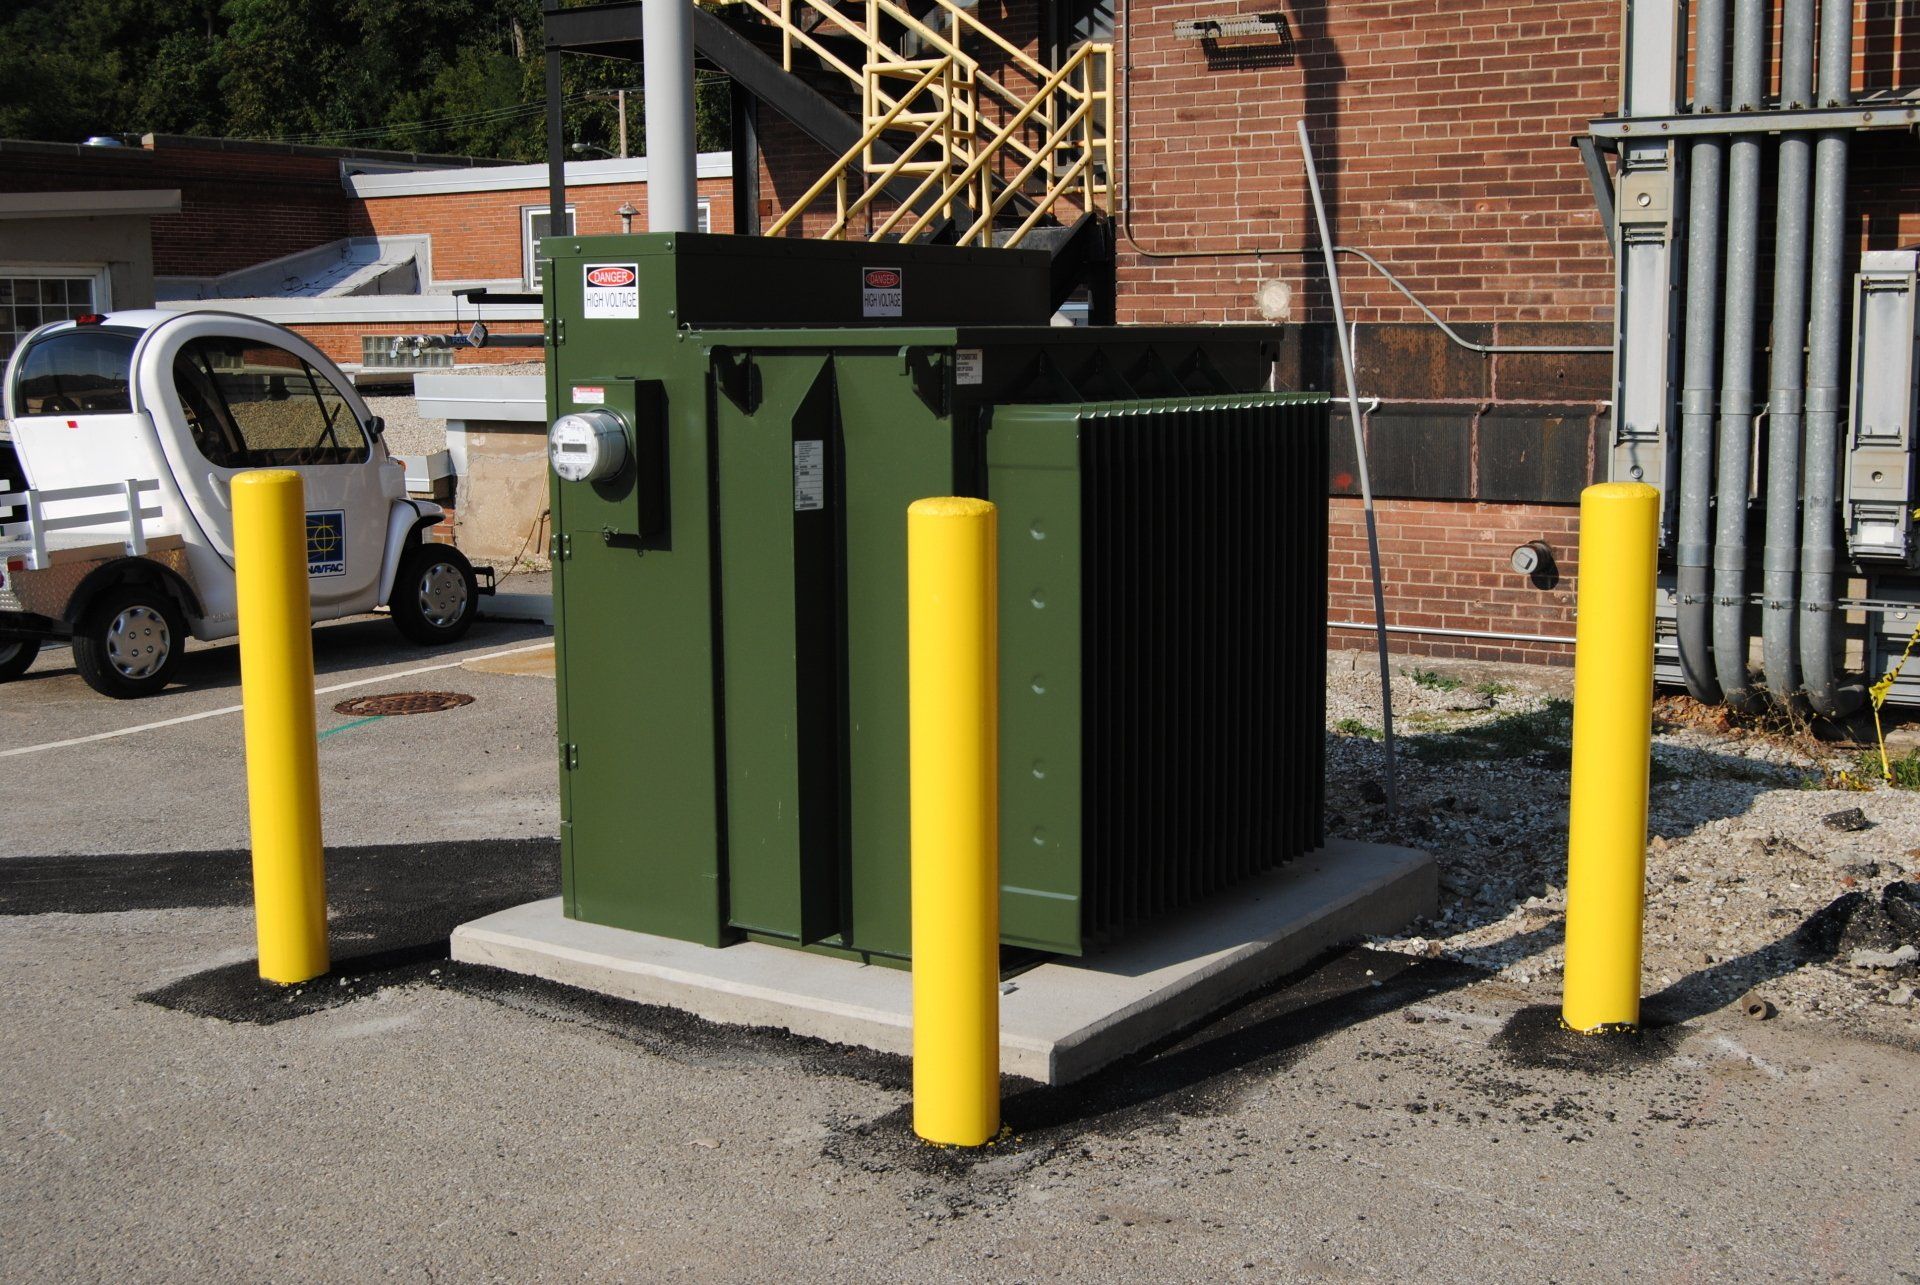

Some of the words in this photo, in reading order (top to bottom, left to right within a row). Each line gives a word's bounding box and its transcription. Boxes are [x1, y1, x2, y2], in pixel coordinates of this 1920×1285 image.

[594, 271, 628, 282] DANGER
[870, 274, 895, 284] DANGER
[586, 292, 604, 307] HIGH
[605, 292, 637, 307] VOLTAGE
[864, 293, 877, 307] HIGH
[878, 293, 901, 307] VOLTAGE
